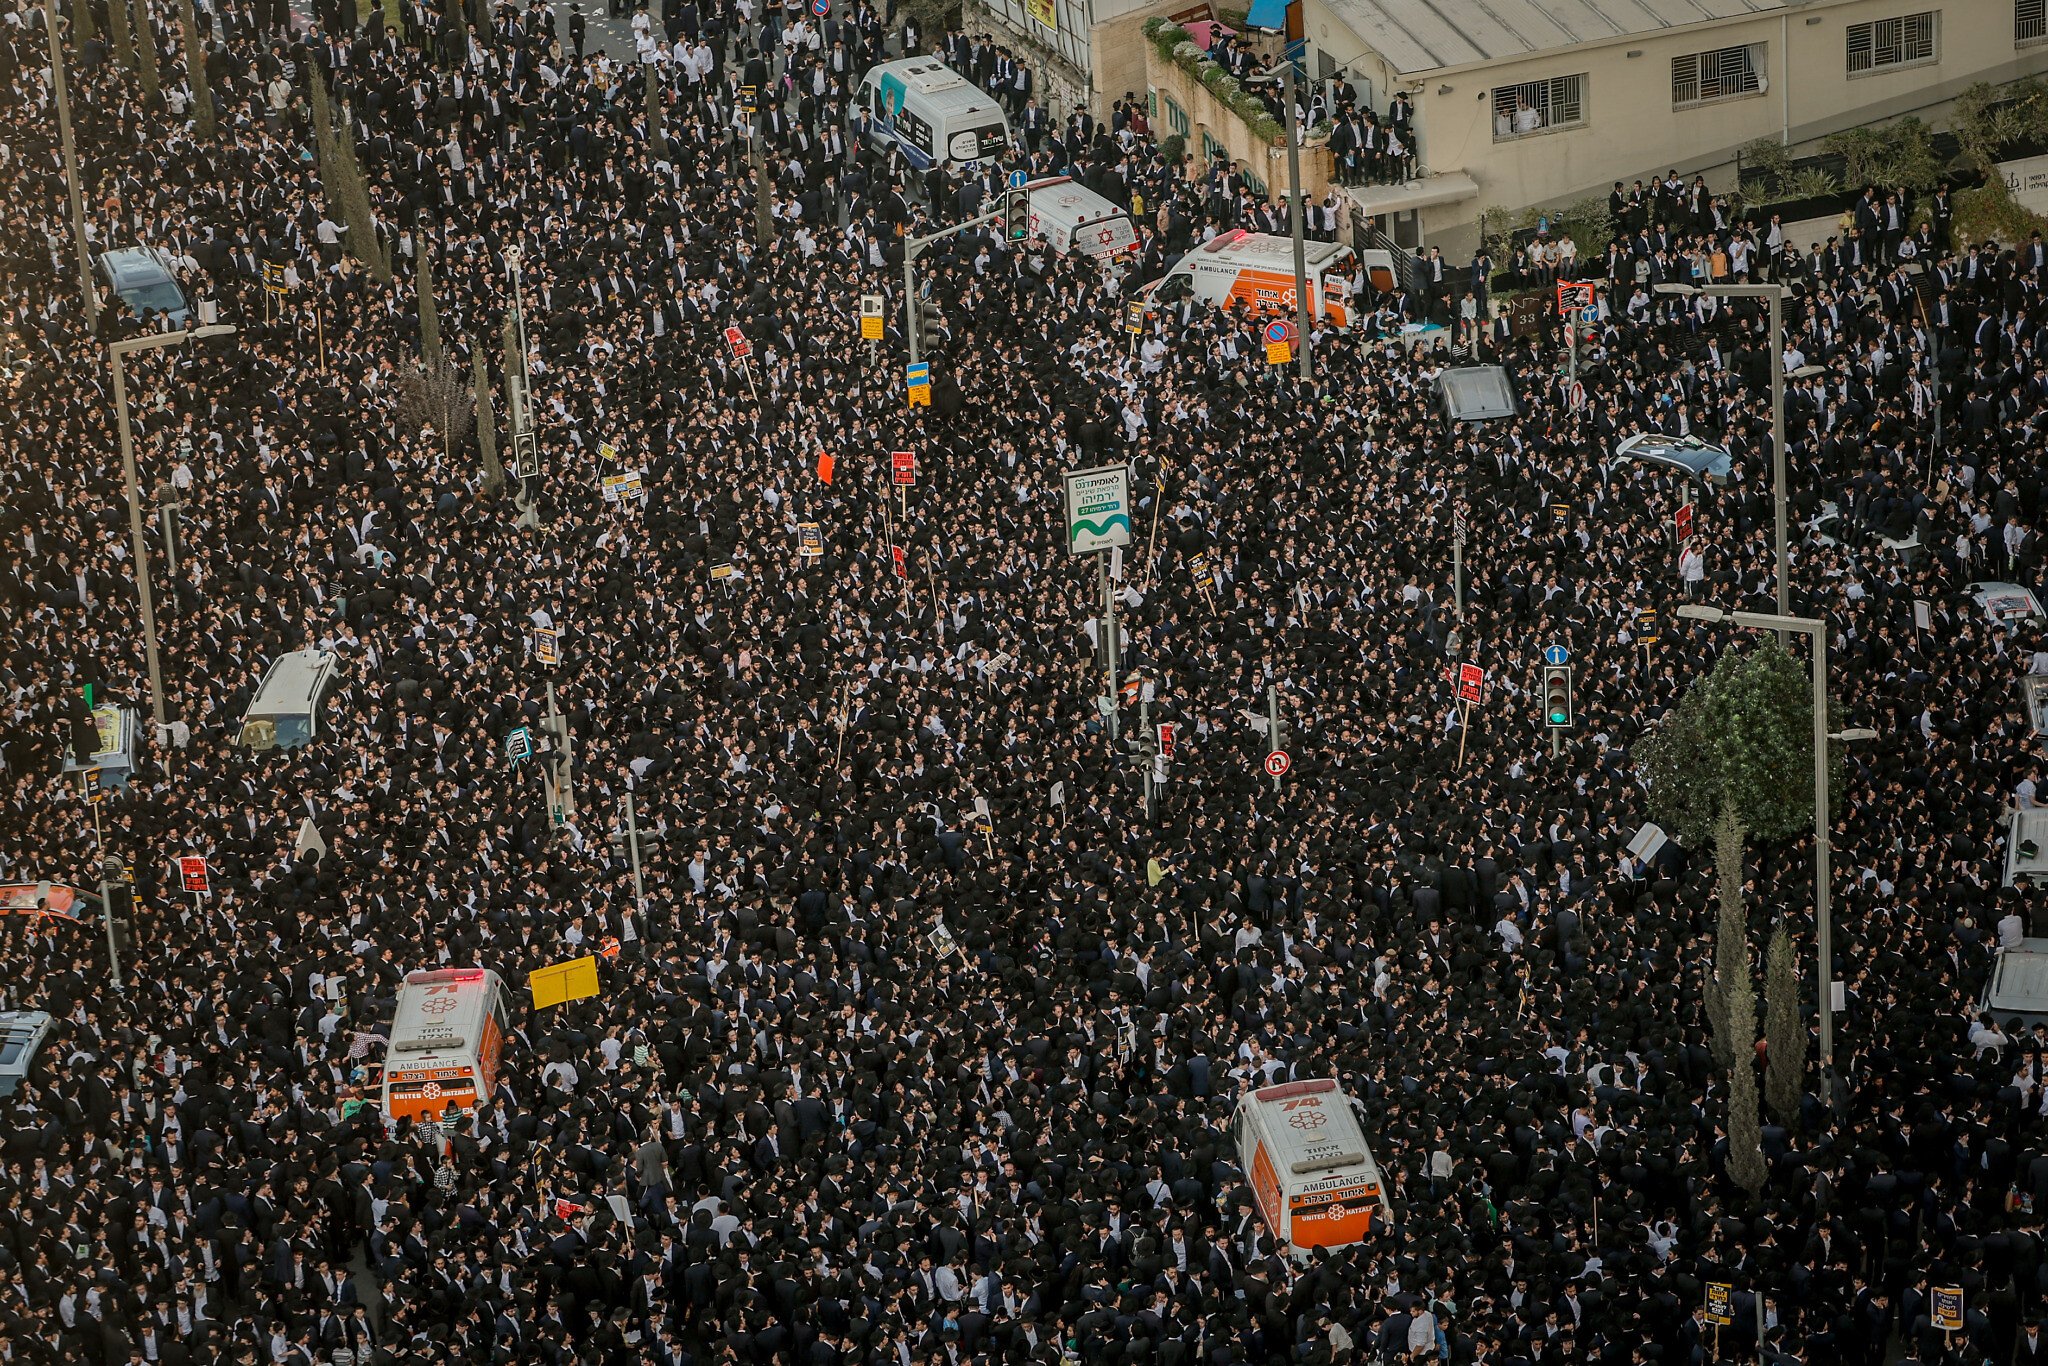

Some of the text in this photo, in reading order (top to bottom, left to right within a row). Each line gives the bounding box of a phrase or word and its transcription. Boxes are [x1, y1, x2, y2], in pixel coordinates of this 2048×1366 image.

[1091, 246, 1129, 260] MBULANCE
[1200, 265, 1237, 275] AMBULANCE
[1255, 289, 1279, 299] איחוד
[1520, 314, 1535, 324] 33
[1097, 485, 1119, 493] מרפאת
[1082, 492, 1114, 505] ירמיהו
[424, 984, 458, 995] 71
[400, 1060, 458, 1070] AMBULANCE
[1279, 1097, 1322, 1111] 74
[1304, 1144, 1340, 1153] איחוד
[1303, 1175, 1366, 1192] AMBULANCE
[1304, 1188, 1366, 1205] איחוד הצלה
